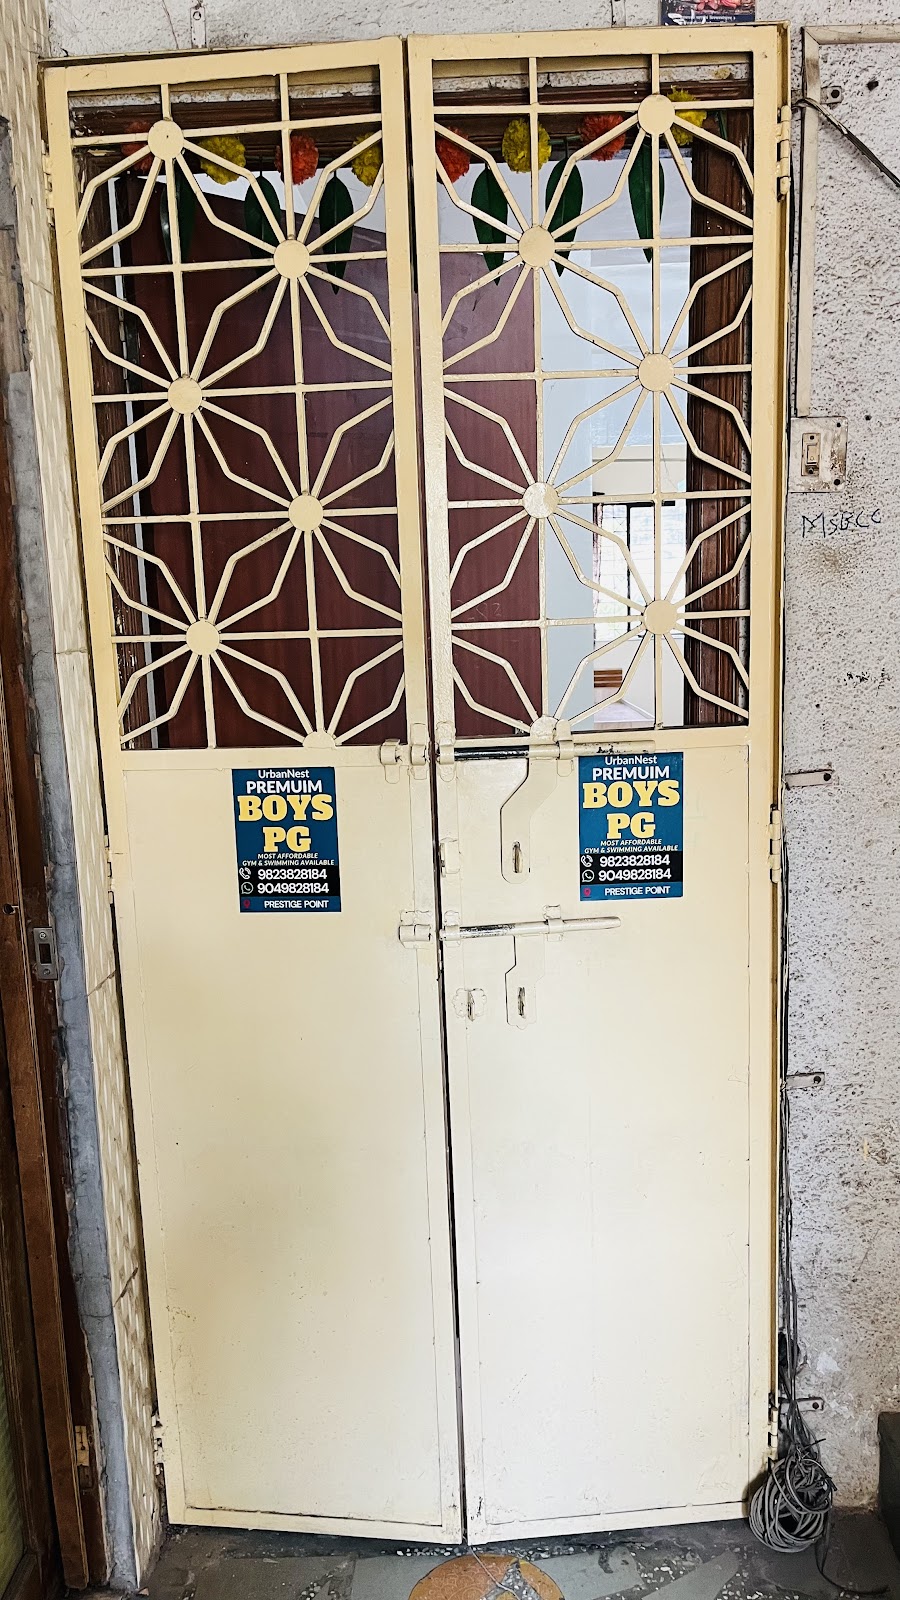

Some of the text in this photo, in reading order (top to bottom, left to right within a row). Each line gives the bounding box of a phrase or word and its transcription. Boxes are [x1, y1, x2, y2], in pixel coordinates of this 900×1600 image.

[604, 755, 658, 765] UrbanNest
[258, 769, 310, 779] UrbanNest
[592, 766, 670, 781] PREMUIM
[246, 780, 323, 794] PREMUIM
[582, 780, 680, 809] BOYS
[237, 794, 334, 821] BOYS
[606, 812, 656, 839] PG
[263, 826, 312, 852] PG
[599, 854, 671, 868] 9823828184
[257, 868, 328, 880] 9823828184
[598, 868, 672, 882] 9049828184
[257, 882, 330, 894] 9049828184
[604, 886, 671, 896] PRESTIGE POINT
[264, 900, 329, 909] PRESTIGE POINT
